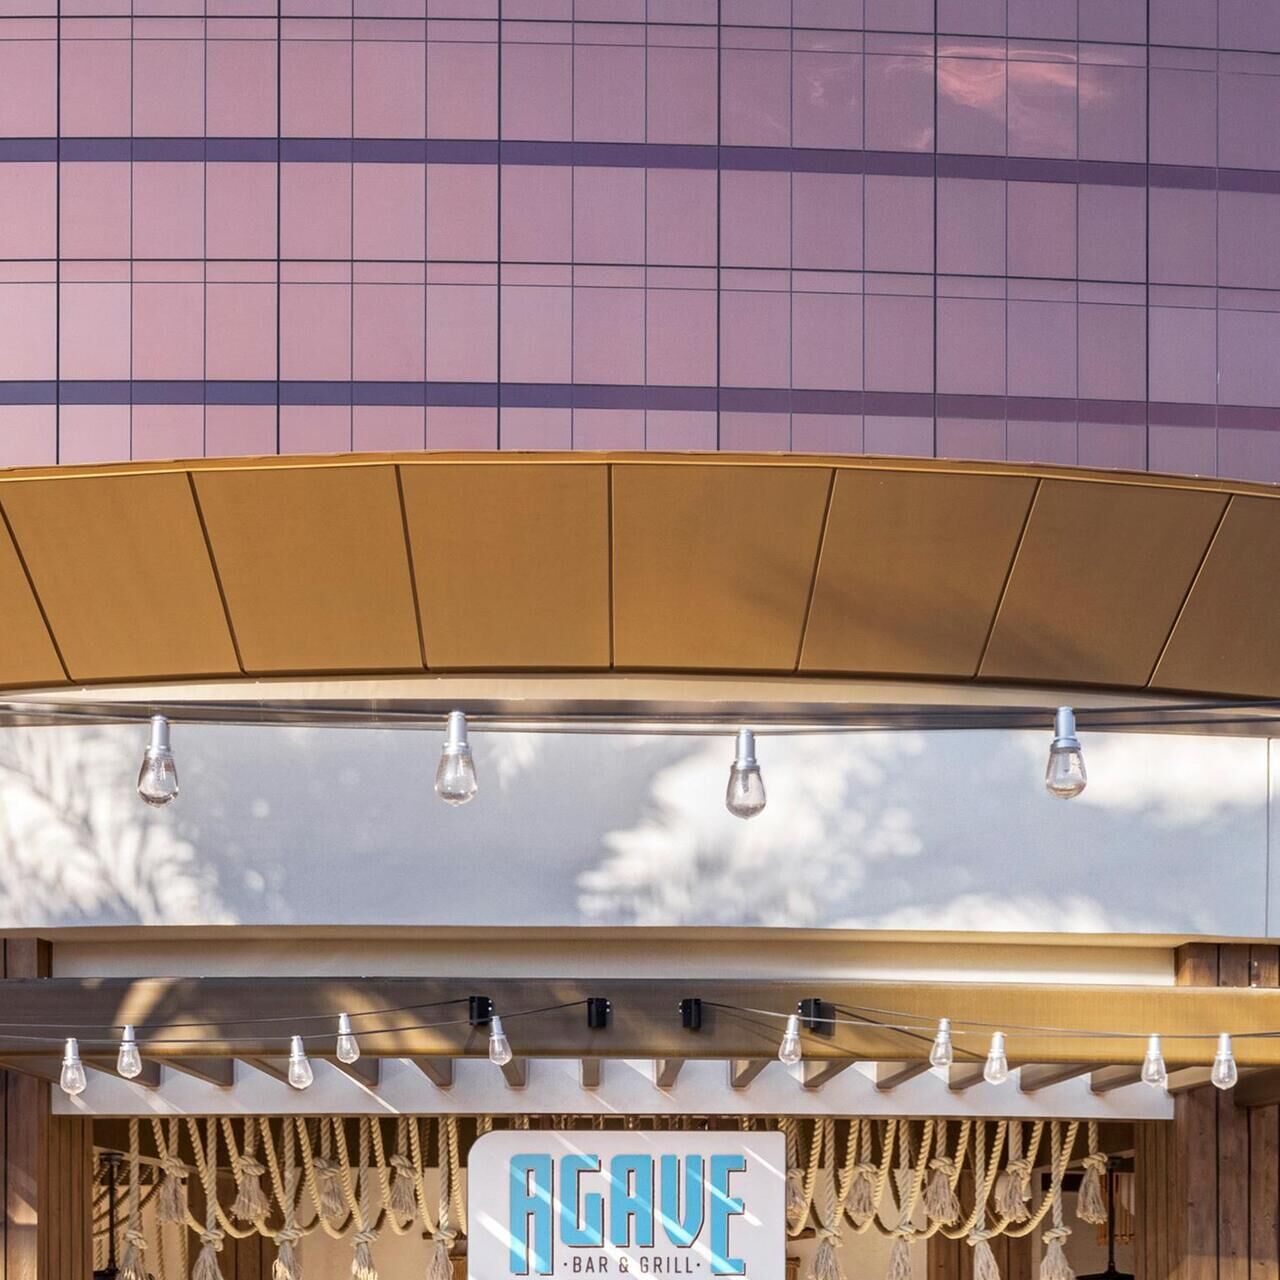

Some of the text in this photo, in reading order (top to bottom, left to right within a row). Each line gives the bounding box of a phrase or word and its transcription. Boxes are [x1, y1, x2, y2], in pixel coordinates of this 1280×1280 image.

[509, 1154, 747, 1276] AGAVE
[572, 1256, 694, 1274] BAR & GRILL
